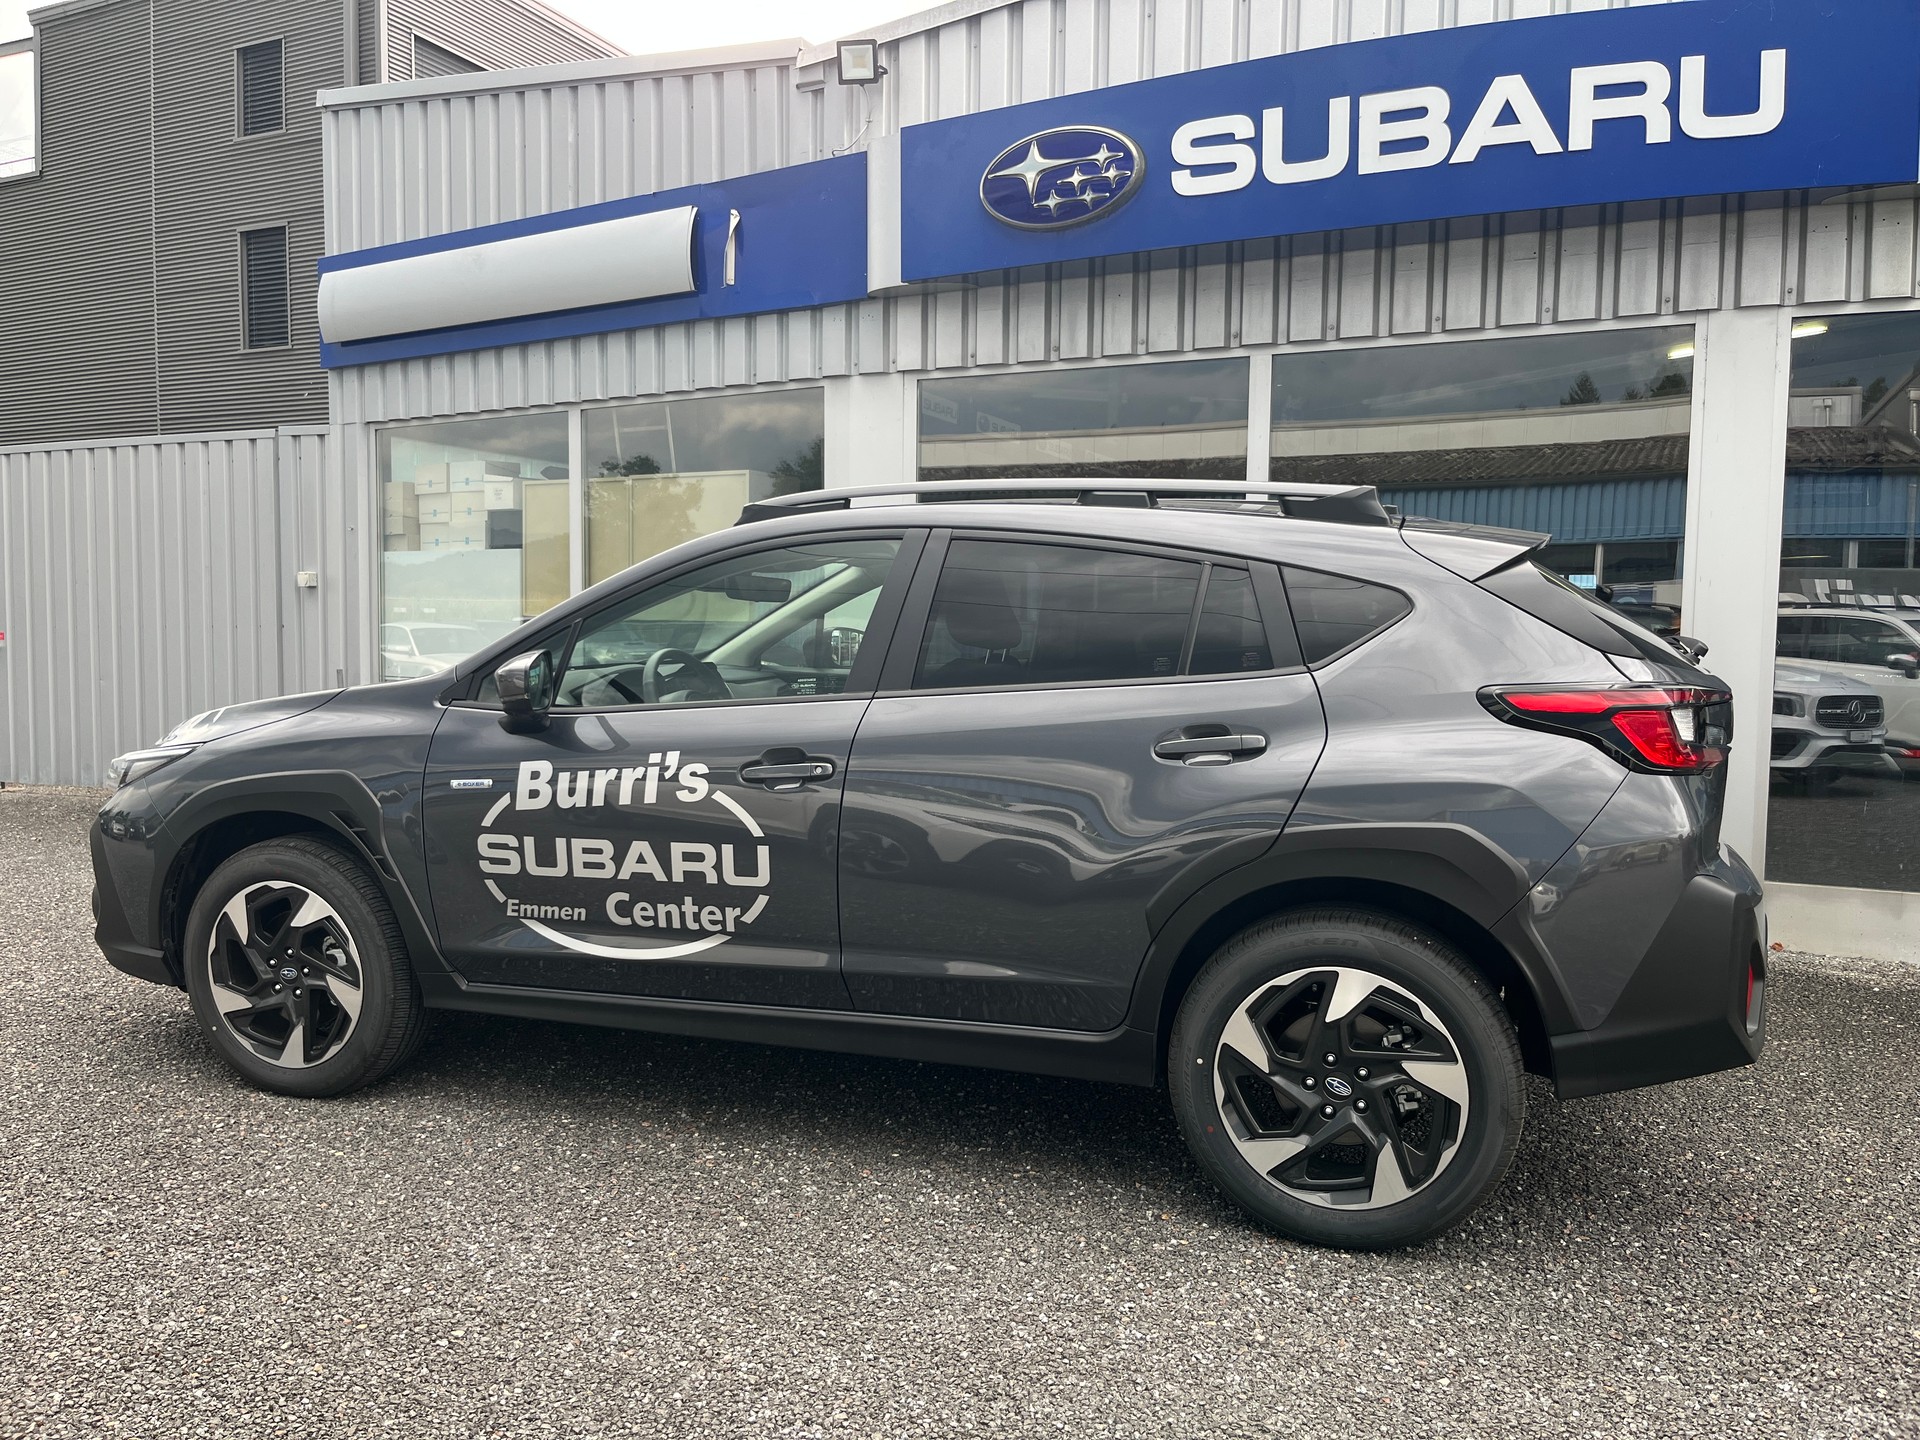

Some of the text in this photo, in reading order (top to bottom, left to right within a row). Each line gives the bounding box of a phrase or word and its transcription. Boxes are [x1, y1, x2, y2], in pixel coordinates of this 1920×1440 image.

[1170, 48, 1787, 196] SUBARU
[477, 833, 771, 887] SUBARU
[506, 891, 741, 932] Emmen Center
